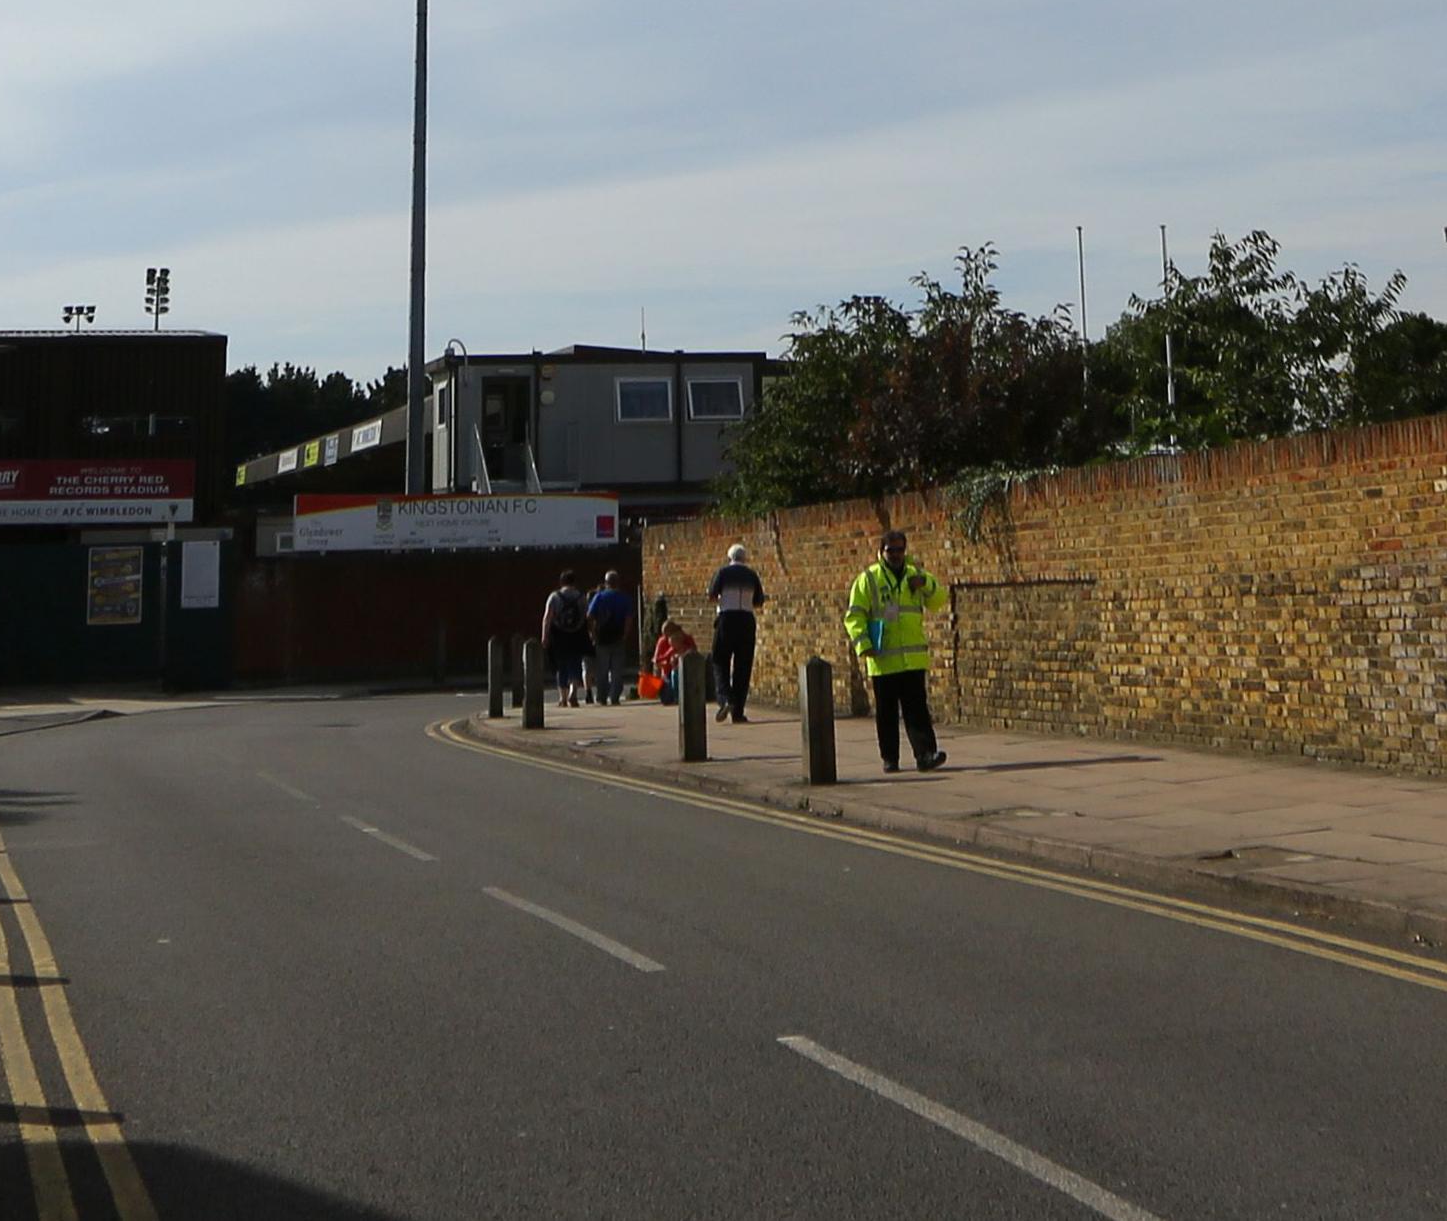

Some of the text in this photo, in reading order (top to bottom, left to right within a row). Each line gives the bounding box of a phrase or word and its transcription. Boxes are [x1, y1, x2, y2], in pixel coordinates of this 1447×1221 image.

[56, 475, 164, 485] THE CHERRY RED
[49, 485, 170, 495] RECORDS STADIUM
[12, 507, 41, 517] HOME
[45, 507, 58, 517] OF
[62, 507, 84, 517] AFC
[86, 506, 152, 516] WIMBLEDON
[398, 498, 541, 515] KINGSTONIAN F.C.
